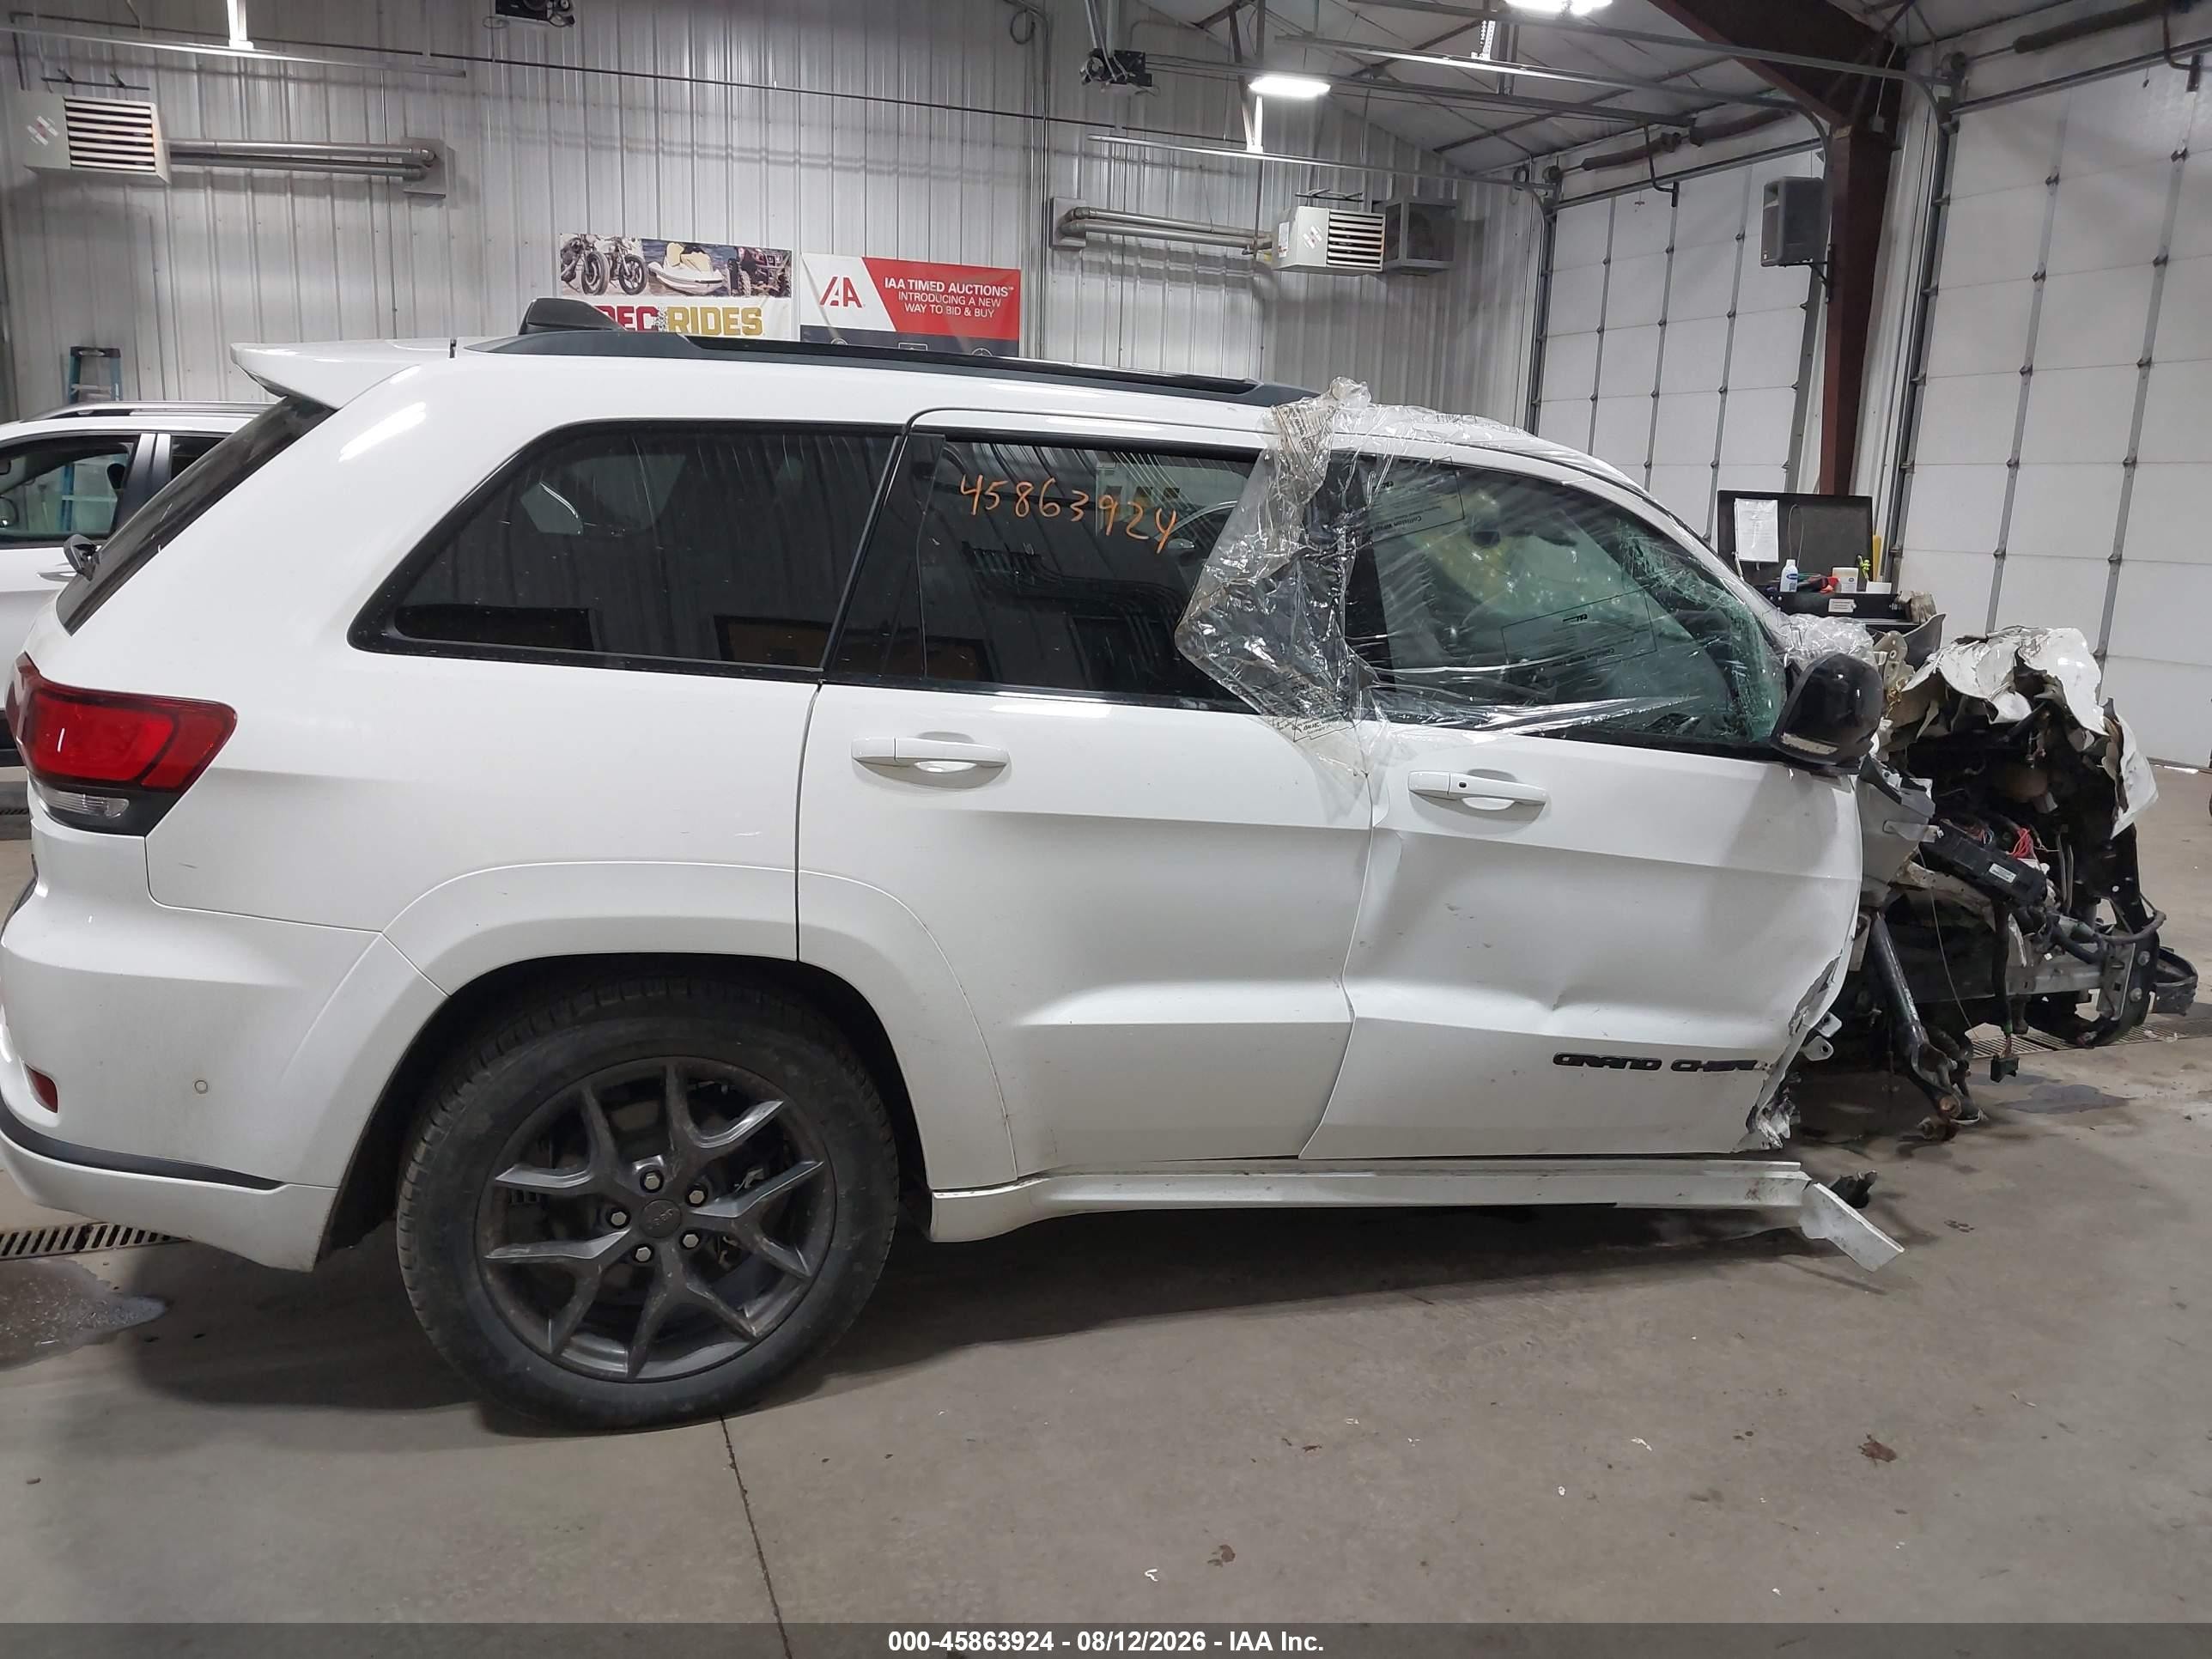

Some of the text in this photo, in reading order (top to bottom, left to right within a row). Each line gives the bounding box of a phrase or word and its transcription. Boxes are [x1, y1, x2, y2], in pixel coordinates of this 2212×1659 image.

[884, 276, 906, 289] IAA
[907, 279, 945, 291] TIMED
[898, 291, 1001, 307] INTRODUCING A NEW
[904, 303, 995, 318] WAY TO BID & BUY
[666, 306, 763, 336] RIDES
[959, 474, 1177, 554] 45863924
[1553, 1052, 1663, 1072] GRAND
